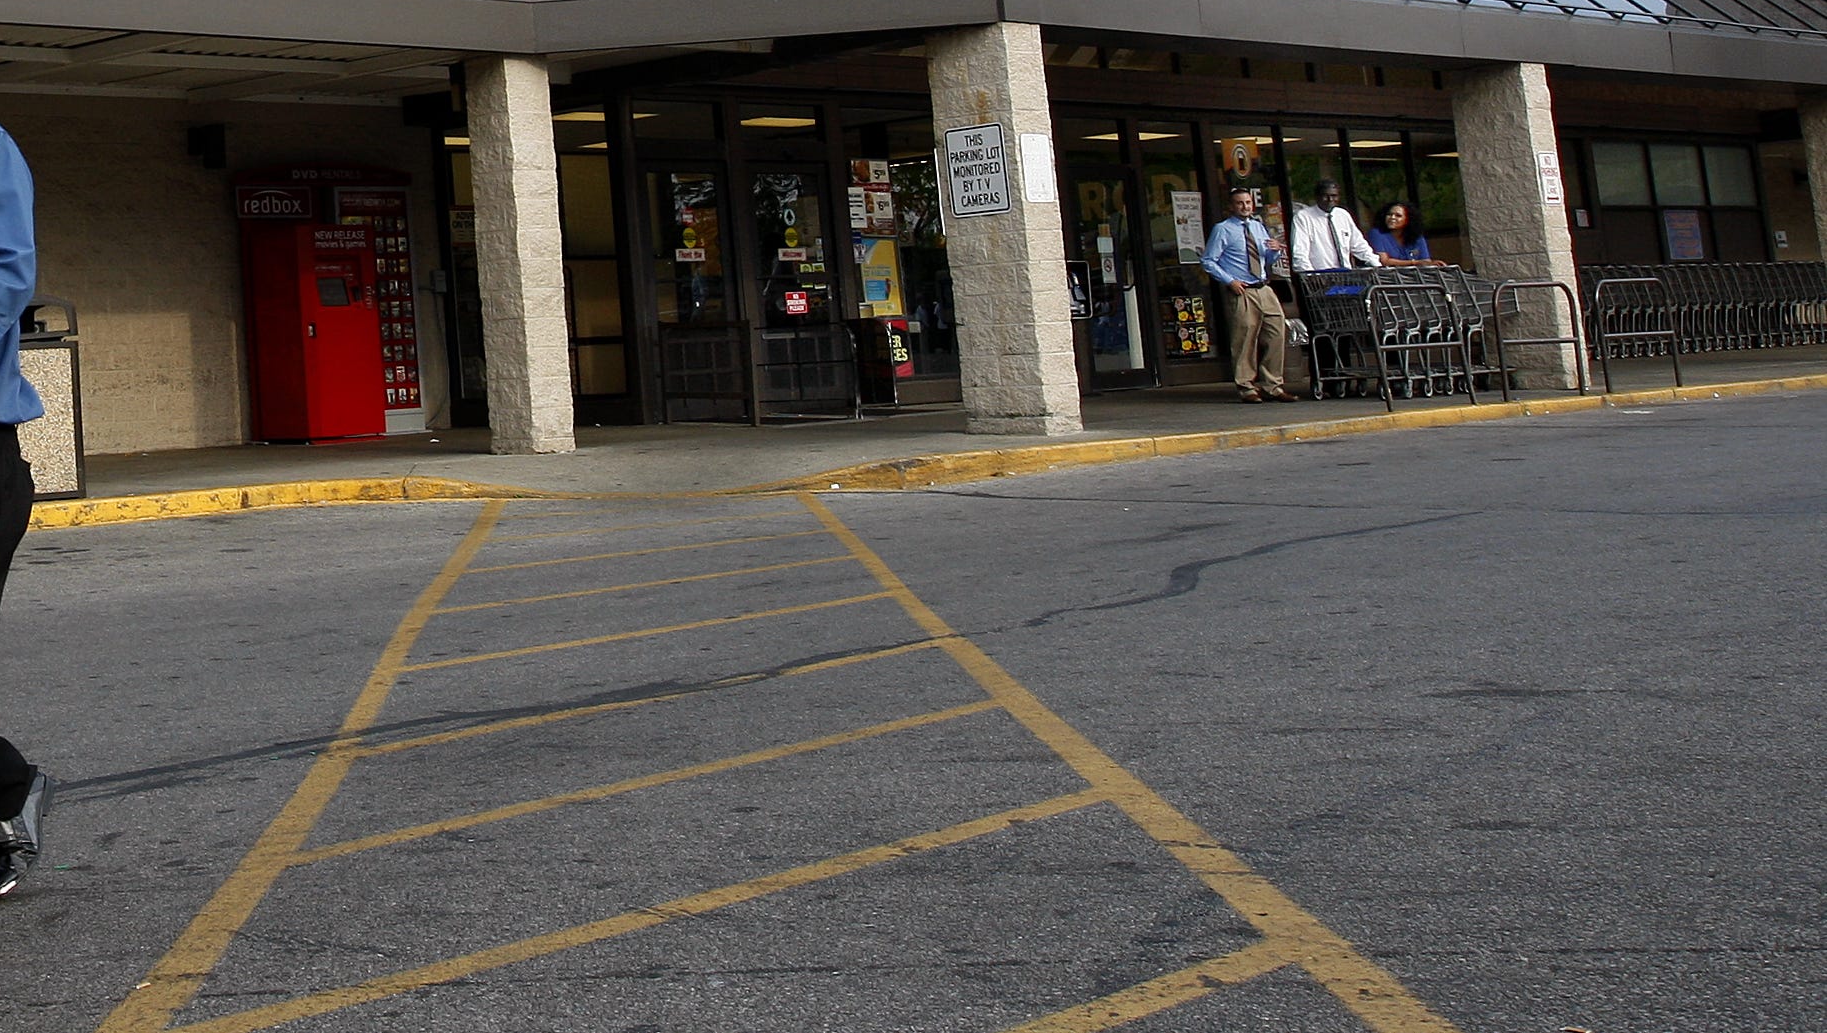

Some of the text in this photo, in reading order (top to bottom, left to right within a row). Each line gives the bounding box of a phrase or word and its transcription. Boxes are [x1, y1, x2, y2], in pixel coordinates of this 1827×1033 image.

[964, 134, 983, 147] THIS
[950, 146, 1000, 163] PARKING LOT
[953, 162, 1001, 178] MONITORED
[963, 180, 974, 193] BY
[243, 196, 304, 214] redbox
[961, 192, 1000, 207] CAMERAS
[314, 230, 365, 240] NEW RELEASE
